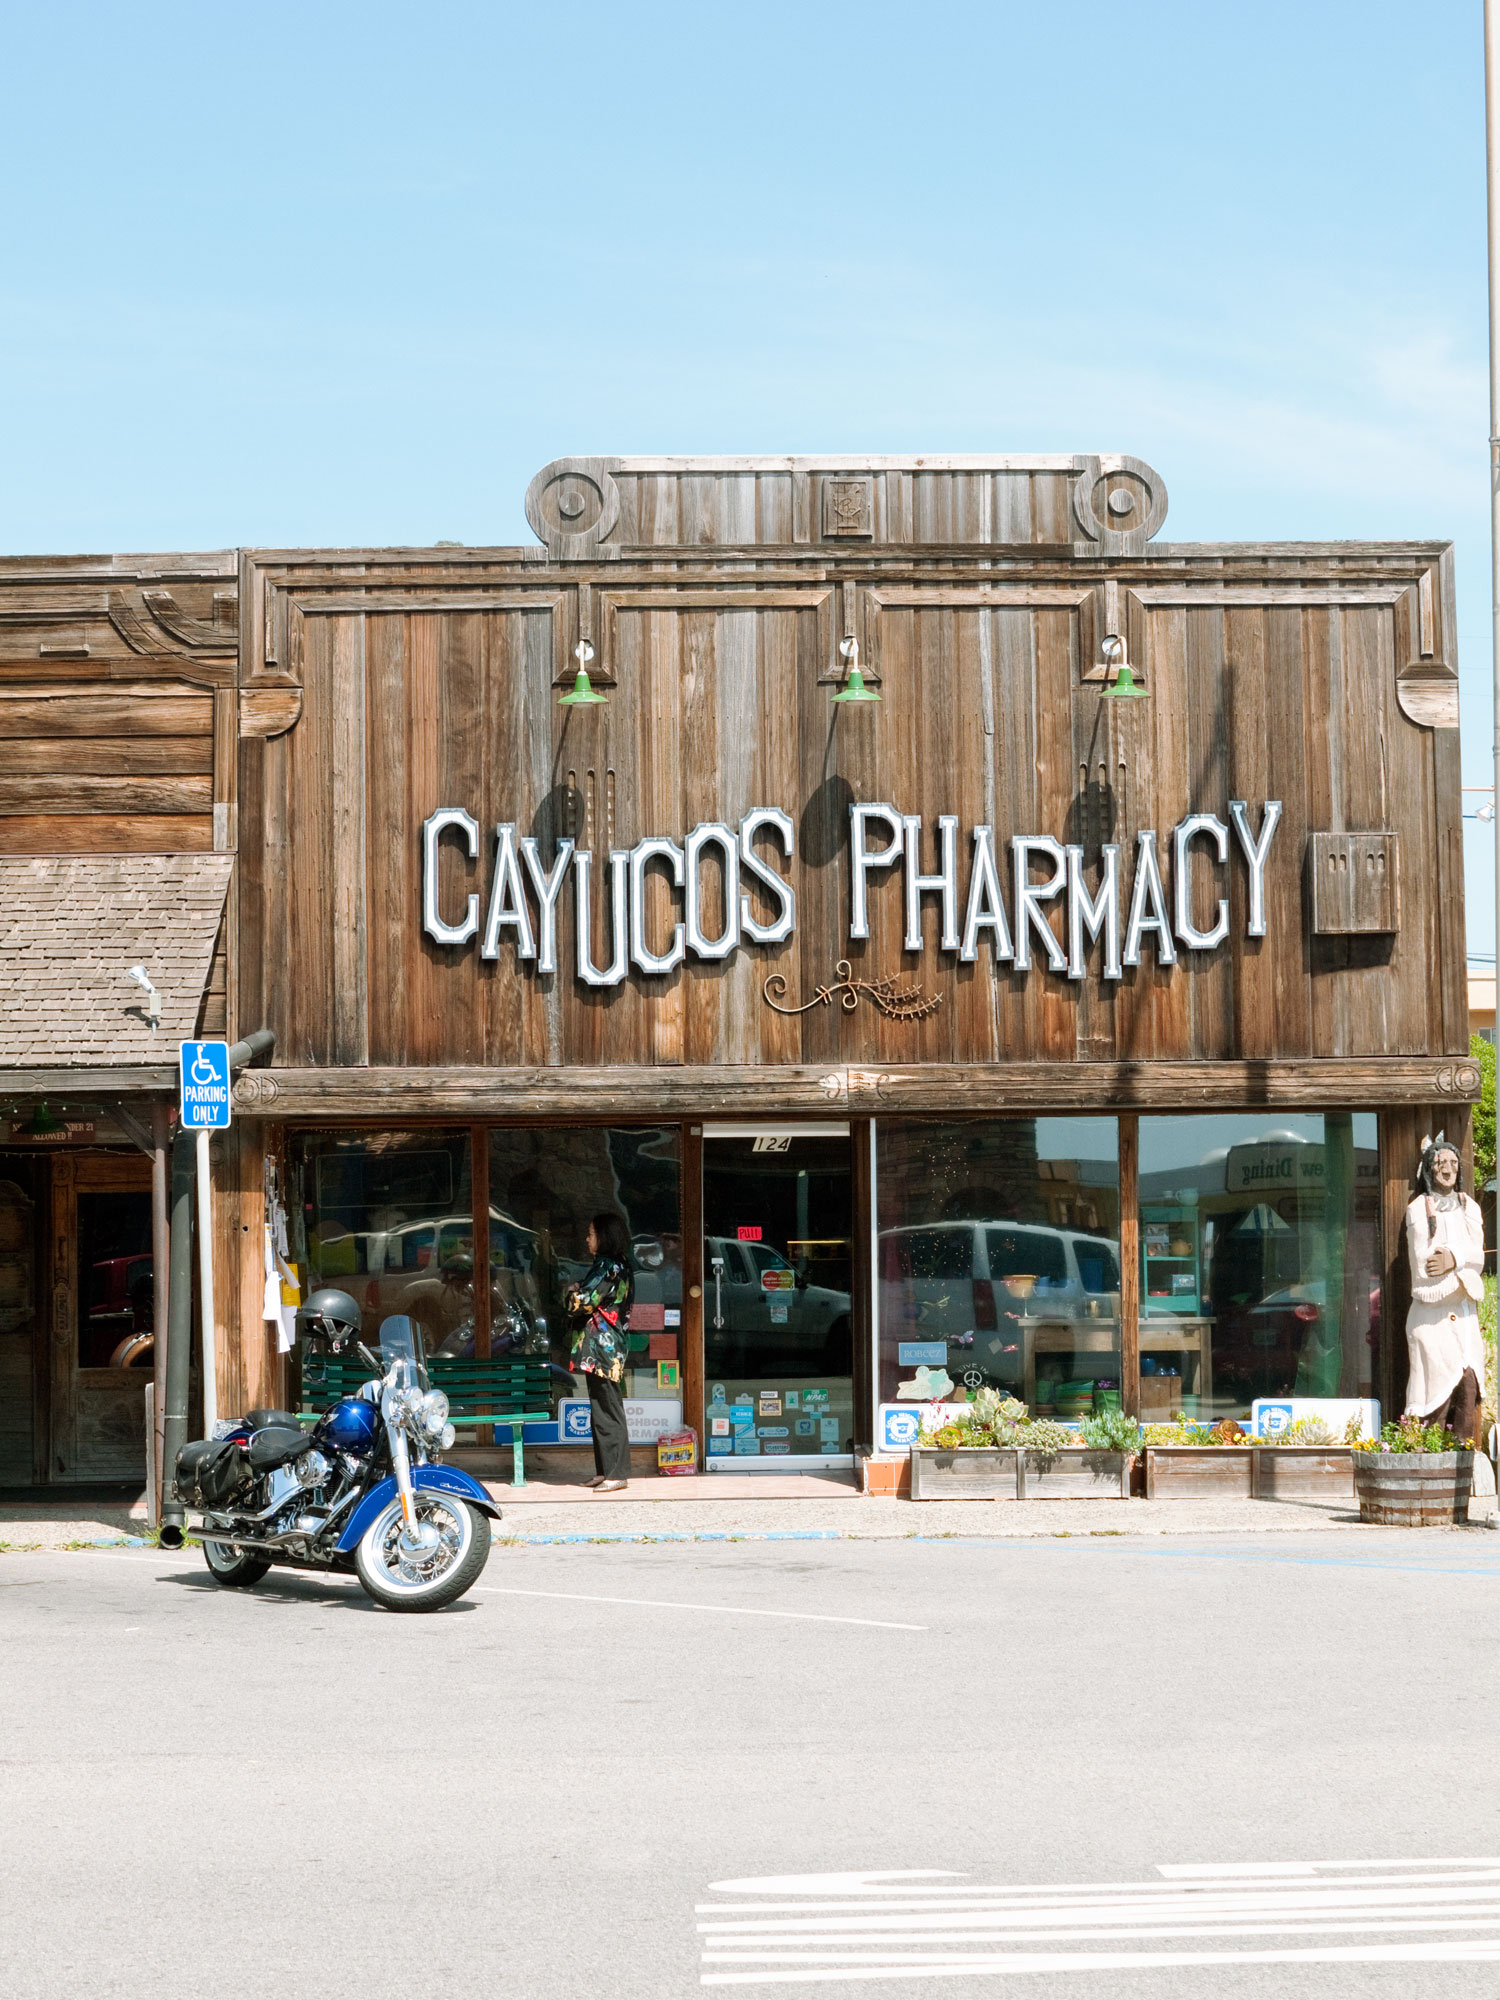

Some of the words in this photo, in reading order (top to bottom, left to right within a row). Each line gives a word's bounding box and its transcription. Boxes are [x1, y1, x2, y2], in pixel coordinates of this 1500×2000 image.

[423, 806, 796, 986] CAYUCOS
[849, 800, 1282, 980] PHARMACY
[185, 1085, 227, 1102] PARKING
[193, 1105, 219, 1121] ONLY
[86, 1123, 94, 1132] 21
[32, 1132, 66, 1141] ALLOWED
[757, 1137, 790, 1150] 124
